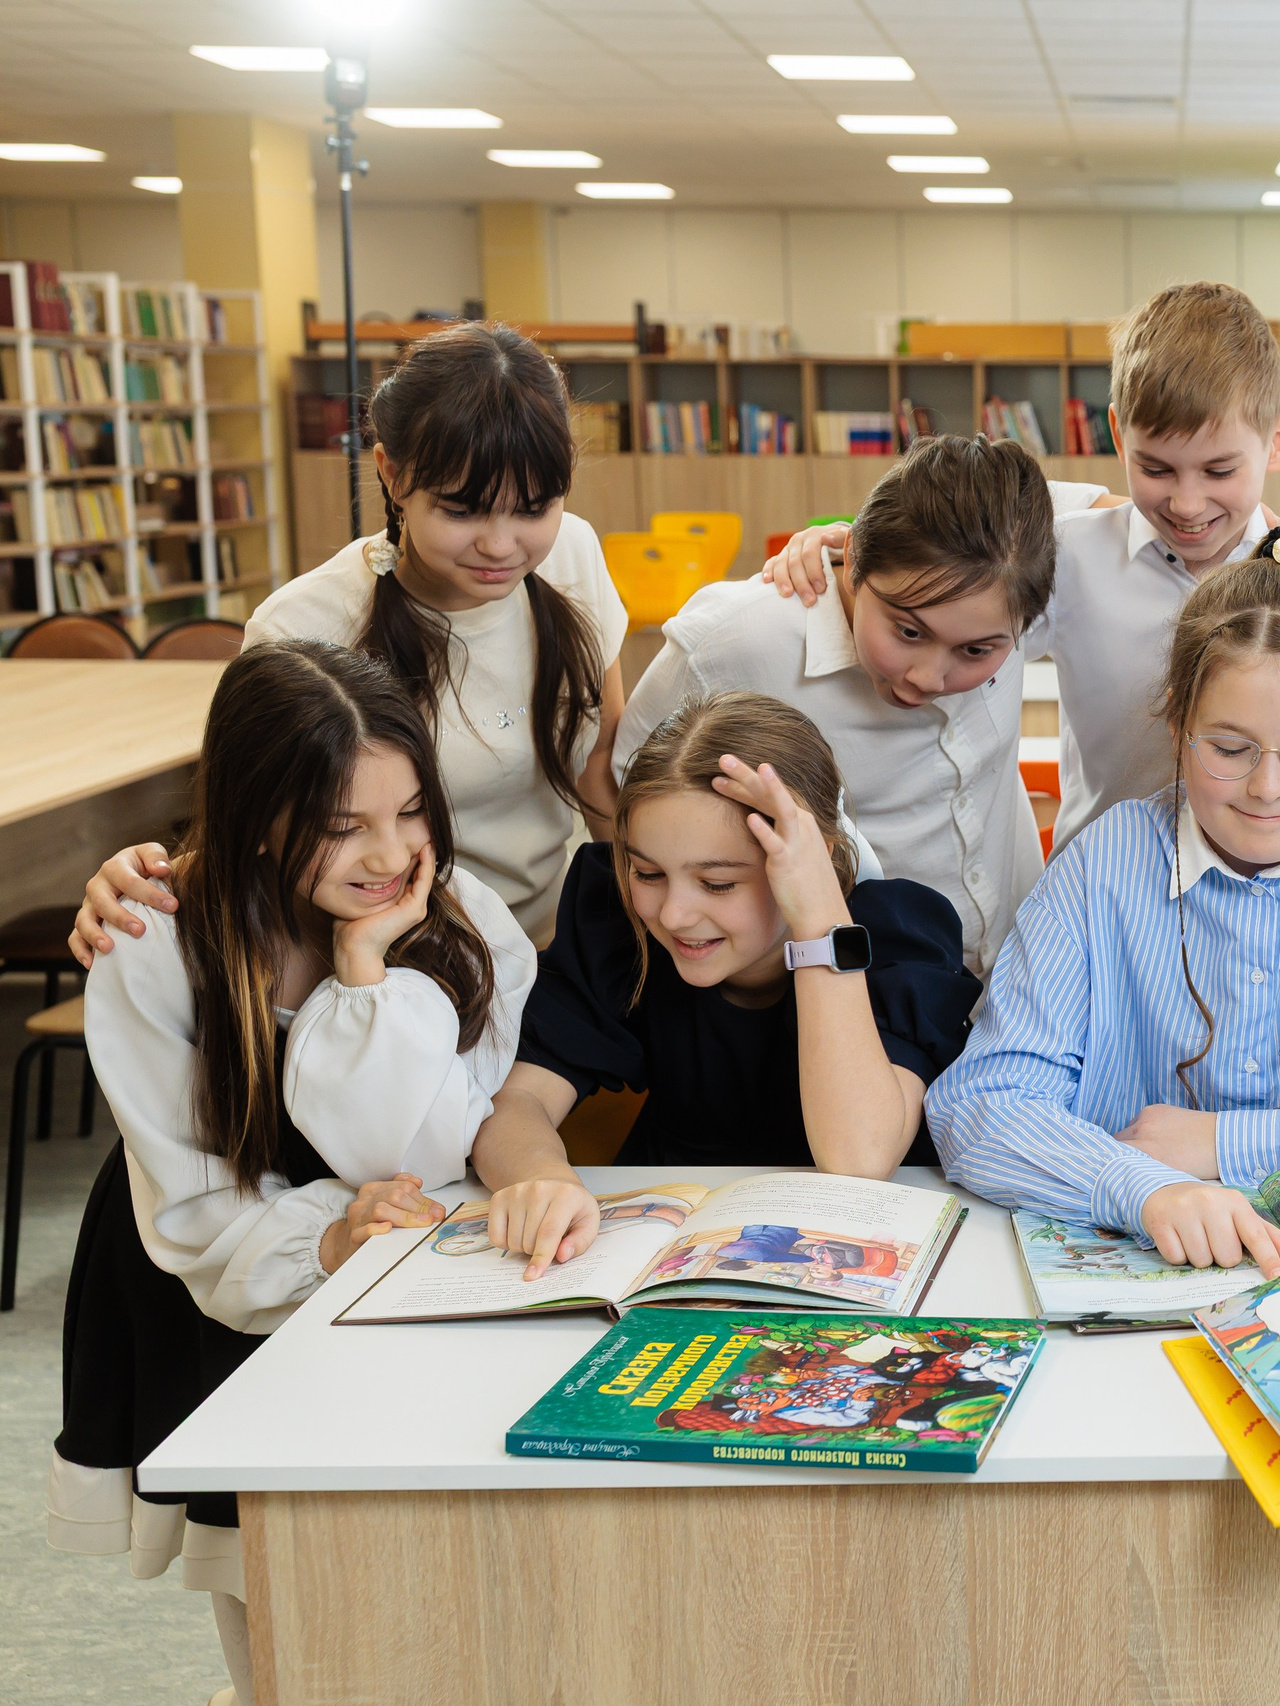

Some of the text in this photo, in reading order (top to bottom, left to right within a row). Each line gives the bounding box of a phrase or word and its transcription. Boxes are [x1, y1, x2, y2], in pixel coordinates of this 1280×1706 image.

[597, 1342, 676, 1395] Сказка
[629, 1334, 718, 1407] Подземного
[669, 1334, 755, 1411] королевства
[522, 1438, 641, 1459] Наталья Городецкая
[713, 1446, 906, 1468] Сказка Подземного королевства
